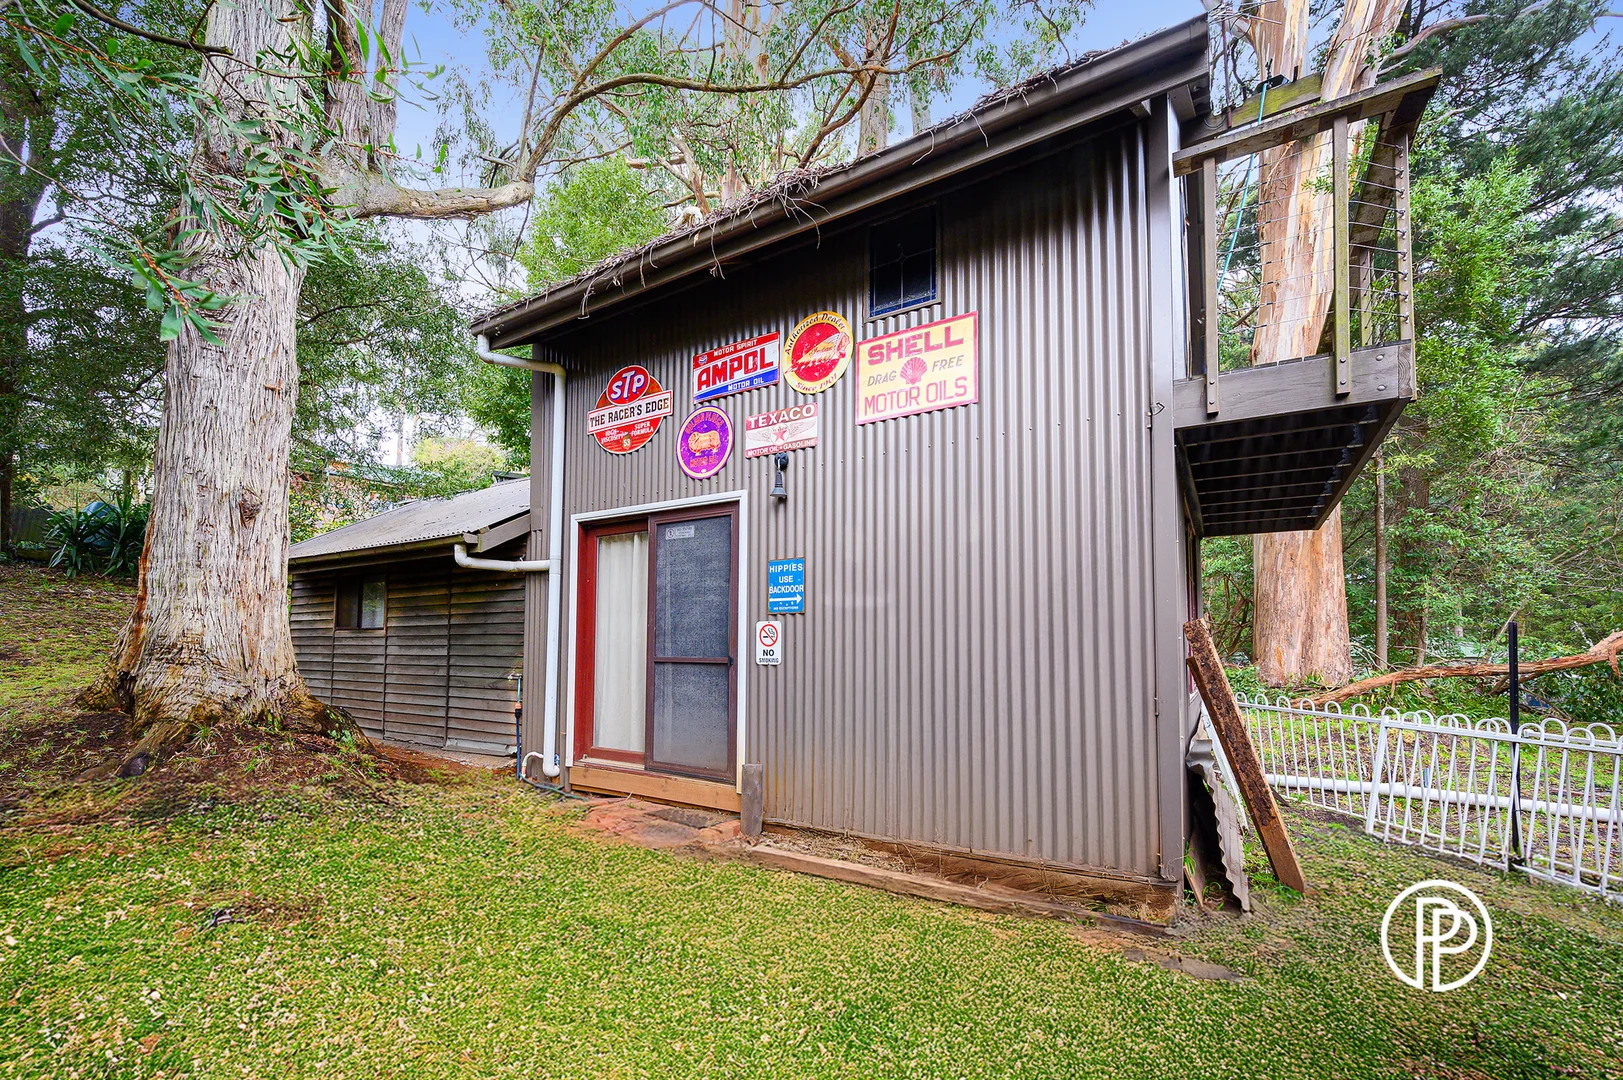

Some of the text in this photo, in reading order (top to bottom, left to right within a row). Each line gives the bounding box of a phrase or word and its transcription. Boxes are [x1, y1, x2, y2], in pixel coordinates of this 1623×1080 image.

[714, 339, 757, 357] MOTOR SPIRIT
[867, 326, 964, 366] SHELL
[697, 347, 774, 391] AMPOL
[867, 355, 964, 387] DRAG FREE
[610, 370, 645, 399] STP
[728, 377, 764, 391] MOTOR OIL
[864, 376, 967, 416] MOTOR OILS
[590, 398, 669, 427] THE RACER'S EDGE
[747, 404, 815, 429] TEXACO
[631, 427, 654, 437] FORMULA
[634, 421, 650, 430] SUPER
[747, 439, 815, 456] MOTOR OIL GASOLINE
[769, 563, 803, 573] HIPPIES
[778, 575, 794, 583] USE
[768, 584, 804, 594] BACKDOOR
[762, 649, 775, 657] NO
